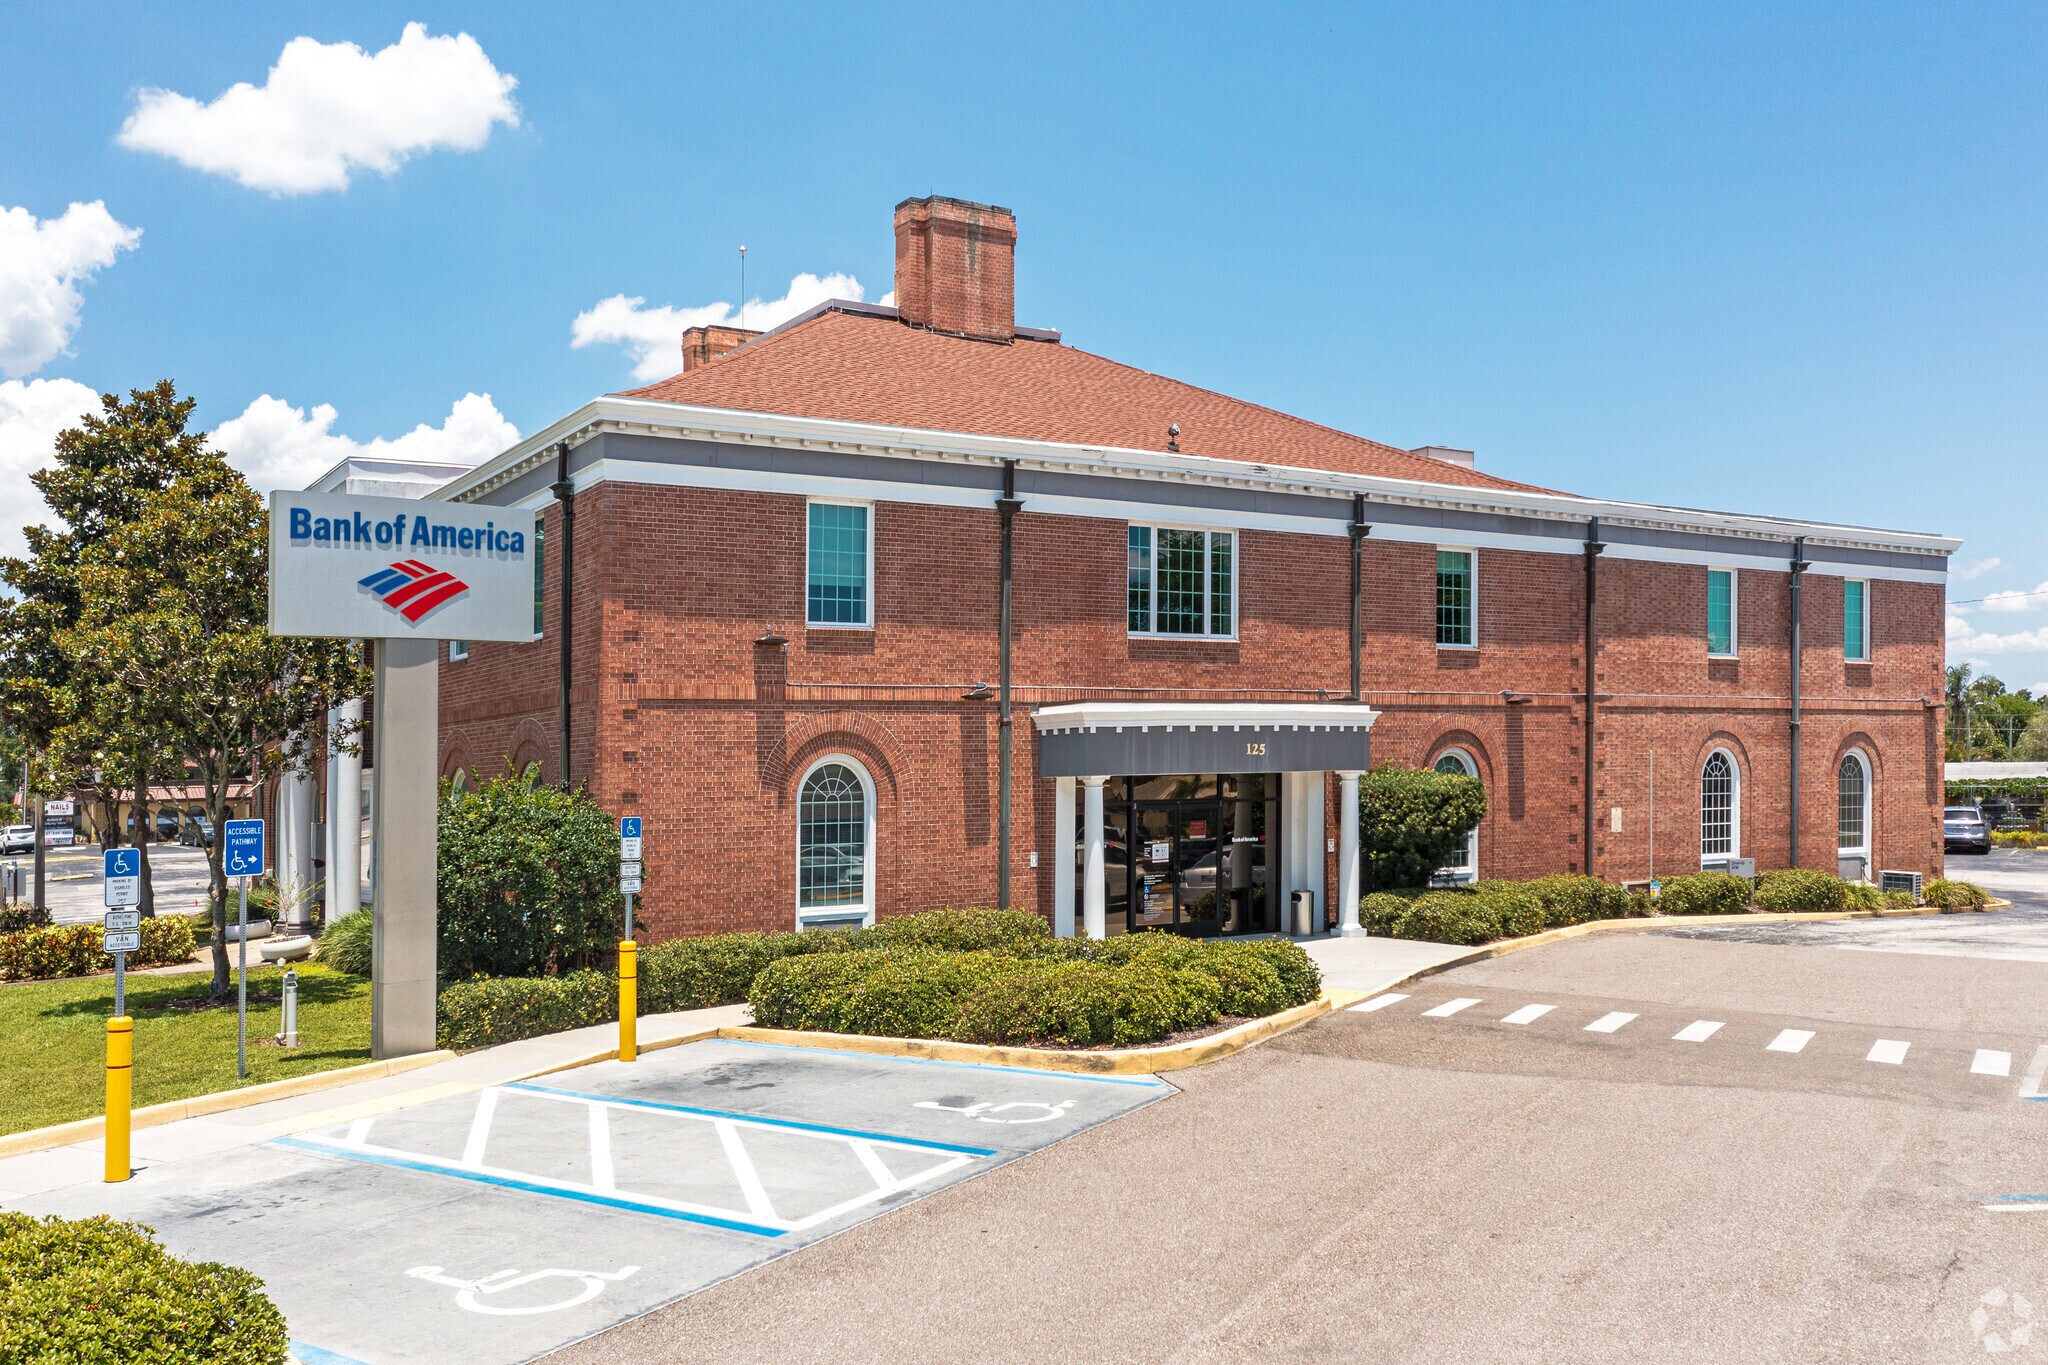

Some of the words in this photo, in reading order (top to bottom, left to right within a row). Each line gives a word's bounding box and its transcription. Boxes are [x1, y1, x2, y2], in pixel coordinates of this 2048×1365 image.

[290, 507, 371, 543] Bank
[375, 513, 406, 545] of
[410, 515, 525, 553] America
[1246, 743, 1266, 756] 125
[228, 827, 261, 835] ACCESSIBLE
[231, 838, 257, 846] PATHWAY
